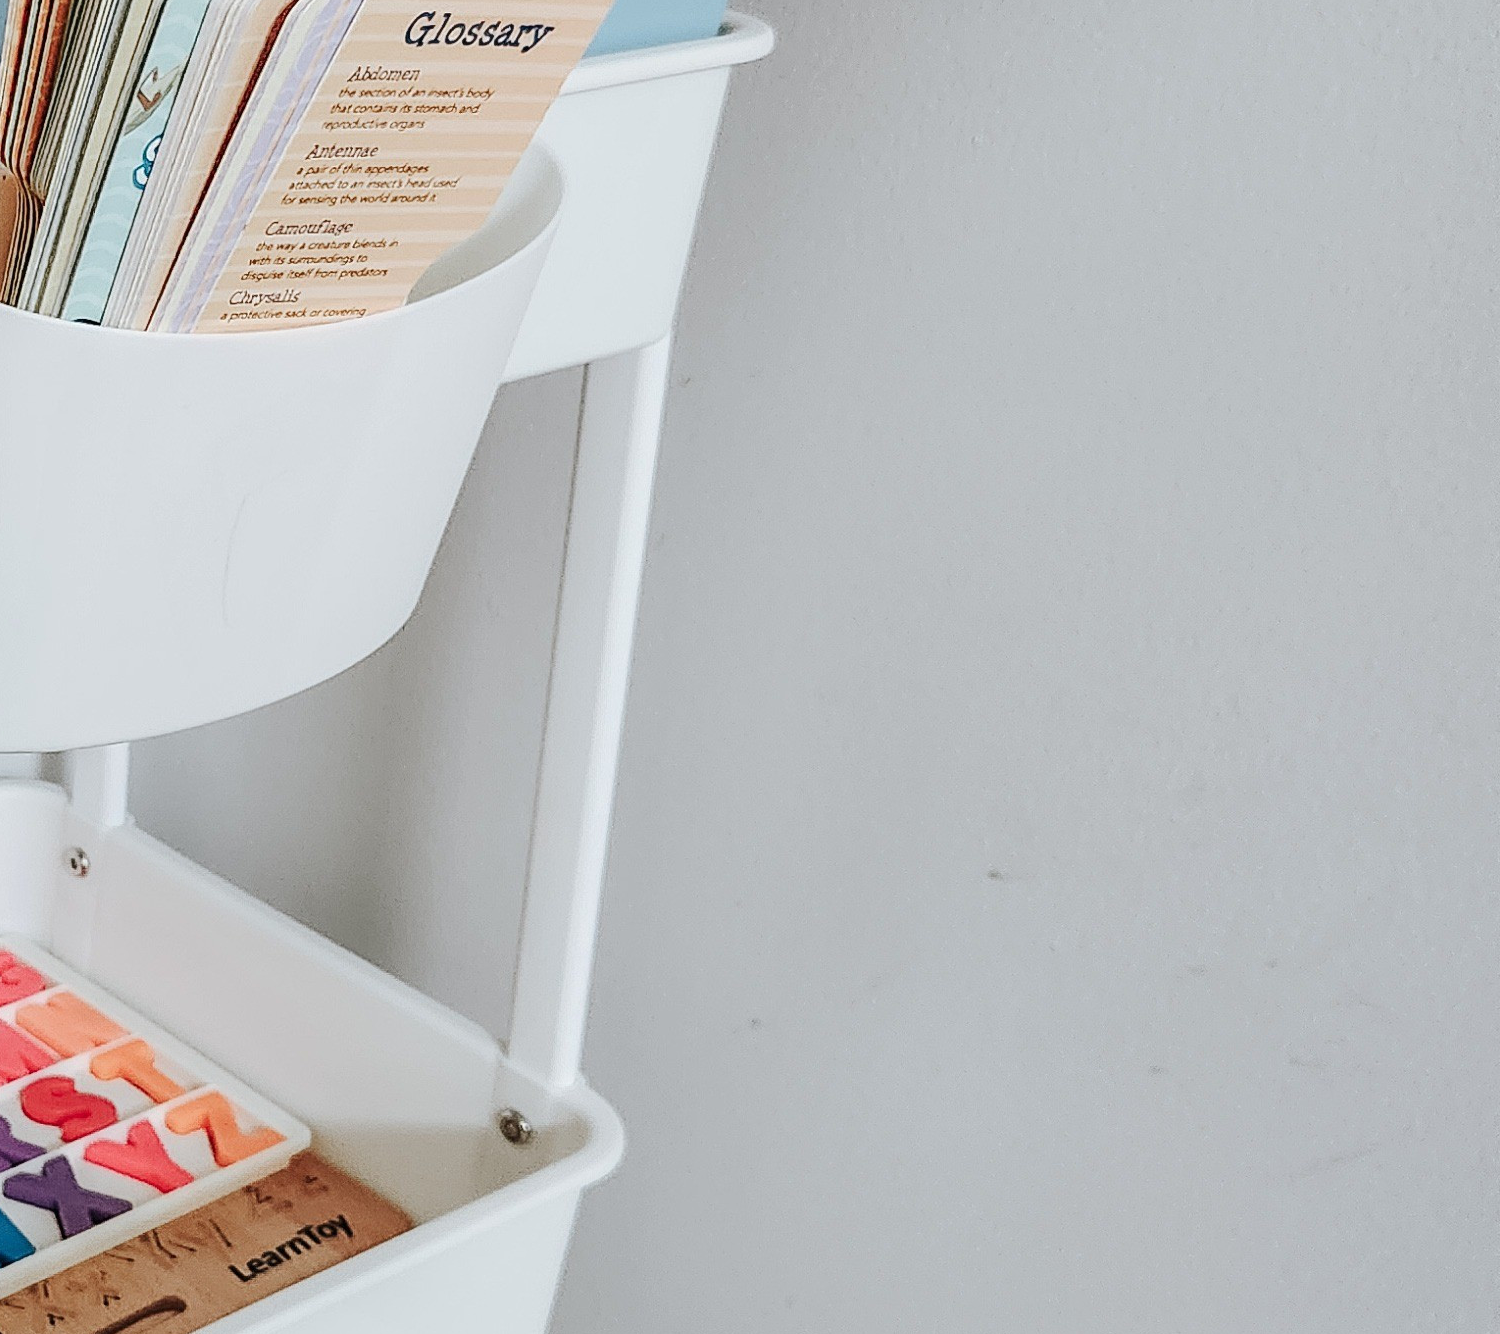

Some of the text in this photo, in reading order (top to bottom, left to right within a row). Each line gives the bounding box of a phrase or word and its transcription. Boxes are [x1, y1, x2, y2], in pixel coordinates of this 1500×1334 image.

[405, 11, 555, 53] Glossary
[347, 66, 421, 82] Abdomen
[339, 87, 494, 101] the section of an insect's body
[331, 103, 481, 114] that contains its stomach and
[321, 119, 426, 131] reproductive organs
[305, 143, 379, 160] Antennae
[297, 163, 429, 178] a pair of thin appendages
[289, 179, 336, 190] attached
[338, 179, 349, 189] to
[350, 181, 364, 189] an
[406, 177, 432, 188] head
[433, 177, 460, 188] used
[281, 193, 437, 207] for sensing the world around it
[265, 220, 354, 236] Camouflage
[256, 238, 399, 253] the way a creature blends in
[249, 253, 368, 266] with its surroundings to
[241, 267, 389, 282] disguise itself from predators
[229, 290, 301, 306] Chrysalis
[220, 307, 366, 323] a protective sack or covering
[15, 991, 128, 1060] N
[22, 1075, 117, 1143] S
[89, 1039, 189, 1102] T
[3, 1155, 133, 1240] X
[84, 1120, 195, 1193] Y
[165, 1091, 286, 1167] Z
[227, 1212, 354, 1282] LearnToy
